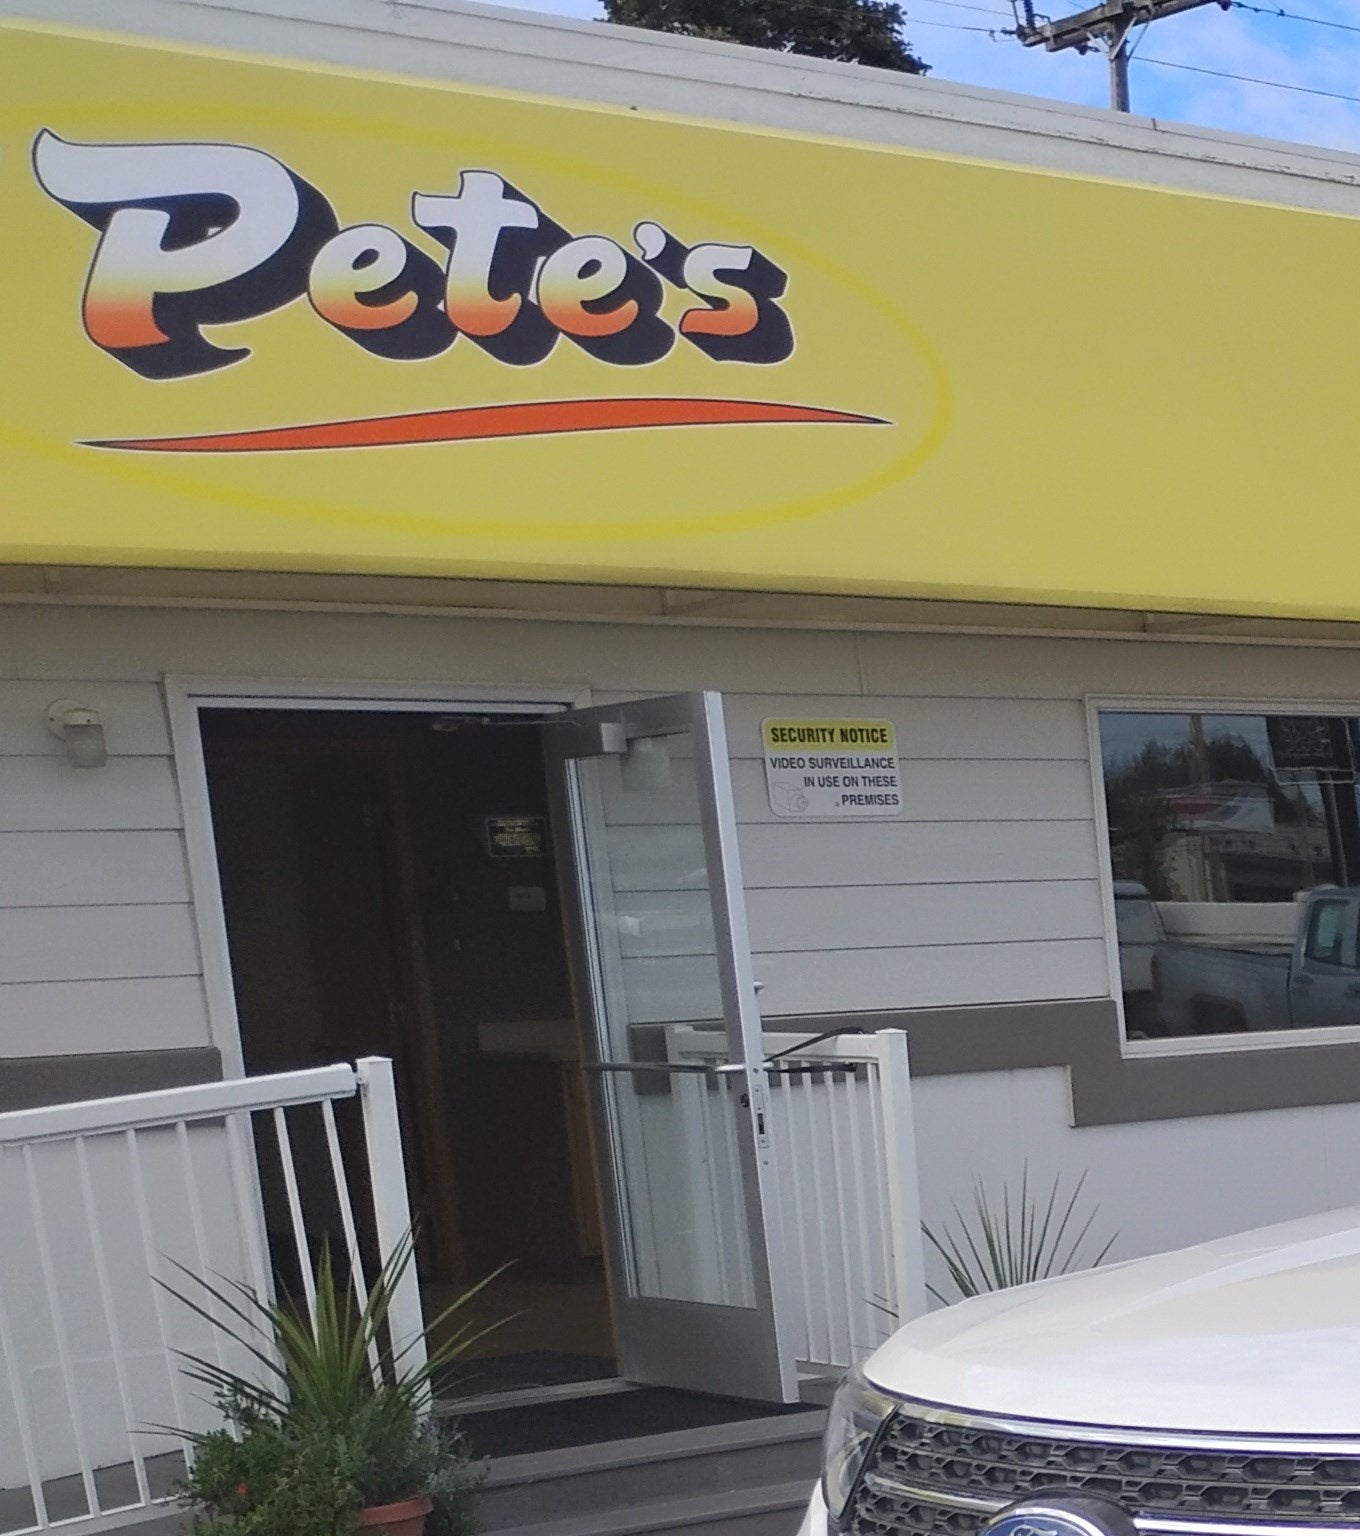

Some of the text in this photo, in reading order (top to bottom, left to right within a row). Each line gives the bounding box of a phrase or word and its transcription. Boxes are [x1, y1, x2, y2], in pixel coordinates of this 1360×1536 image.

[32, 128, 795, 380] Pete's
[771, 728, 888, 743] SECURITY NOTICE
[770, 757, 895, 769] VIDEO SURVEILLANCE
[803, 776, 897, 788] IN USE ON THESE
[841, 794, 899, 806] PREMISES
